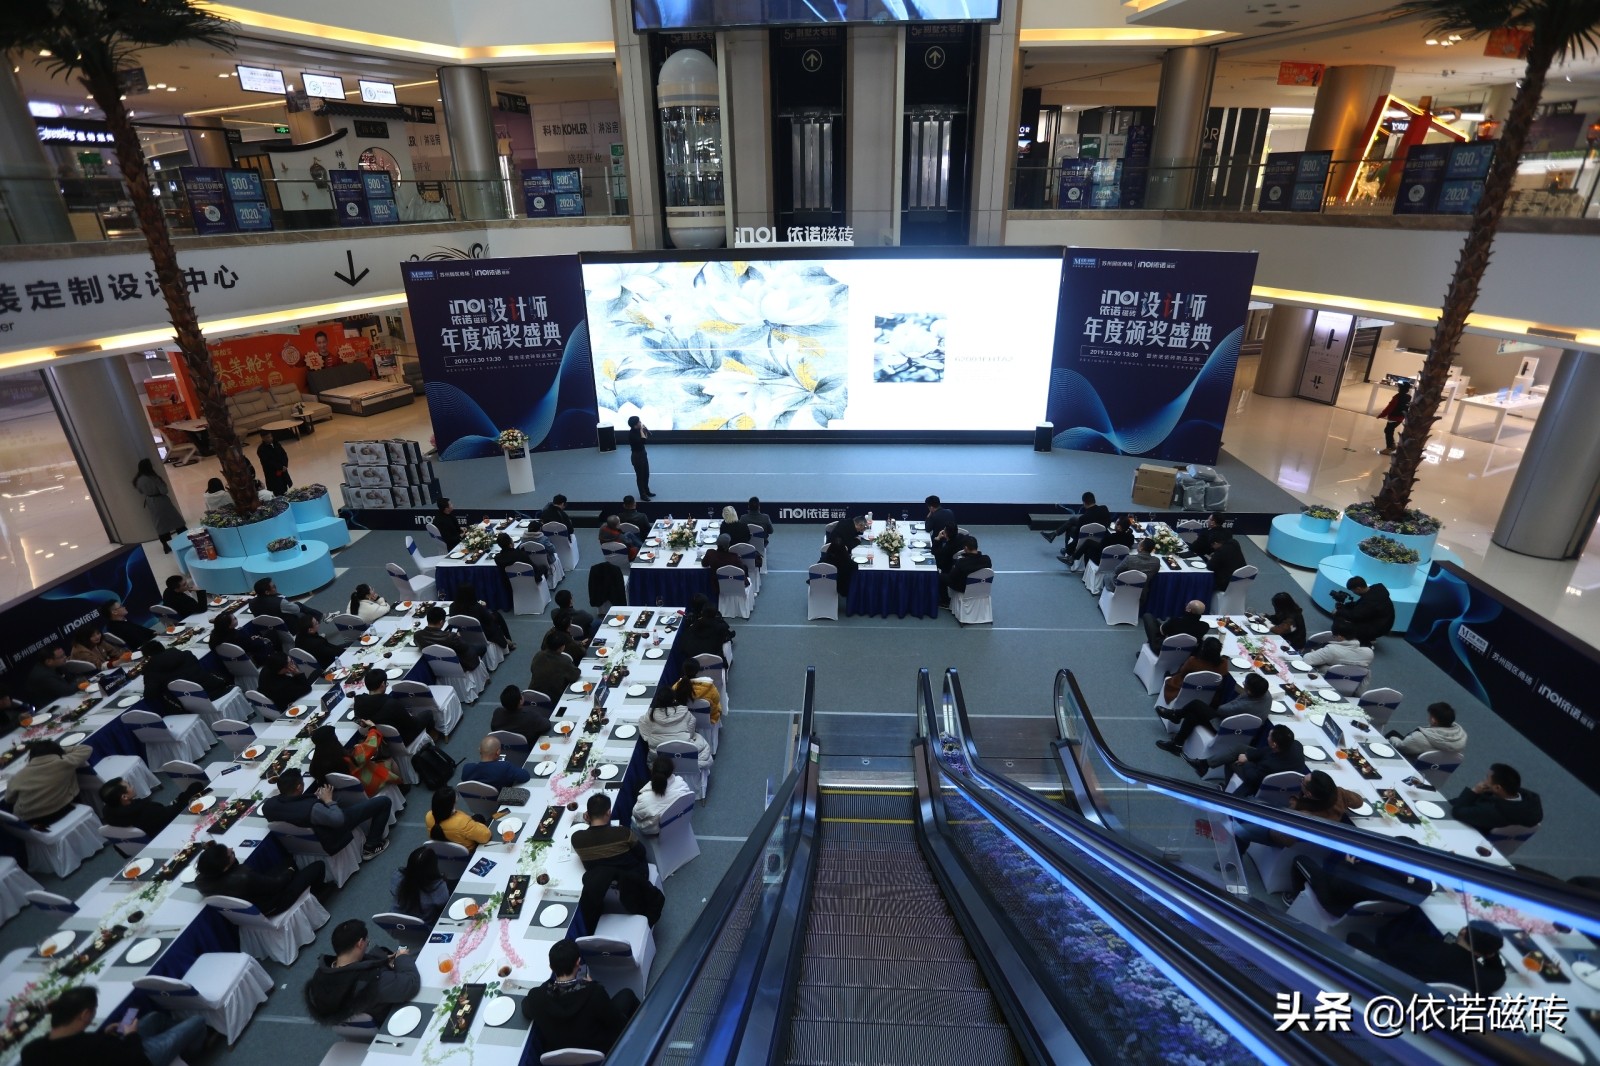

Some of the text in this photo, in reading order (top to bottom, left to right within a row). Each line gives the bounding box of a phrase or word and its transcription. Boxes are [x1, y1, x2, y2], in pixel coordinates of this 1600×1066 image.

[567, 153, 603, 165] 盛装开业
[787, 226, 854, 243] 依诺磁砖
[489, 295, 549, 323] 设计师
[1141, 292, 1208, 321] 设计师
[441, 323, 562, 353] 年度颁奖盛典
[1083, 316, 1213, 350] 年度颁奖盛典
[454, 357, 485, 365] 2019.12.30
[1089, 349, 1121, 357] 2019.12.30
[1491, 652, 1534, 686] 苏州园区商场
